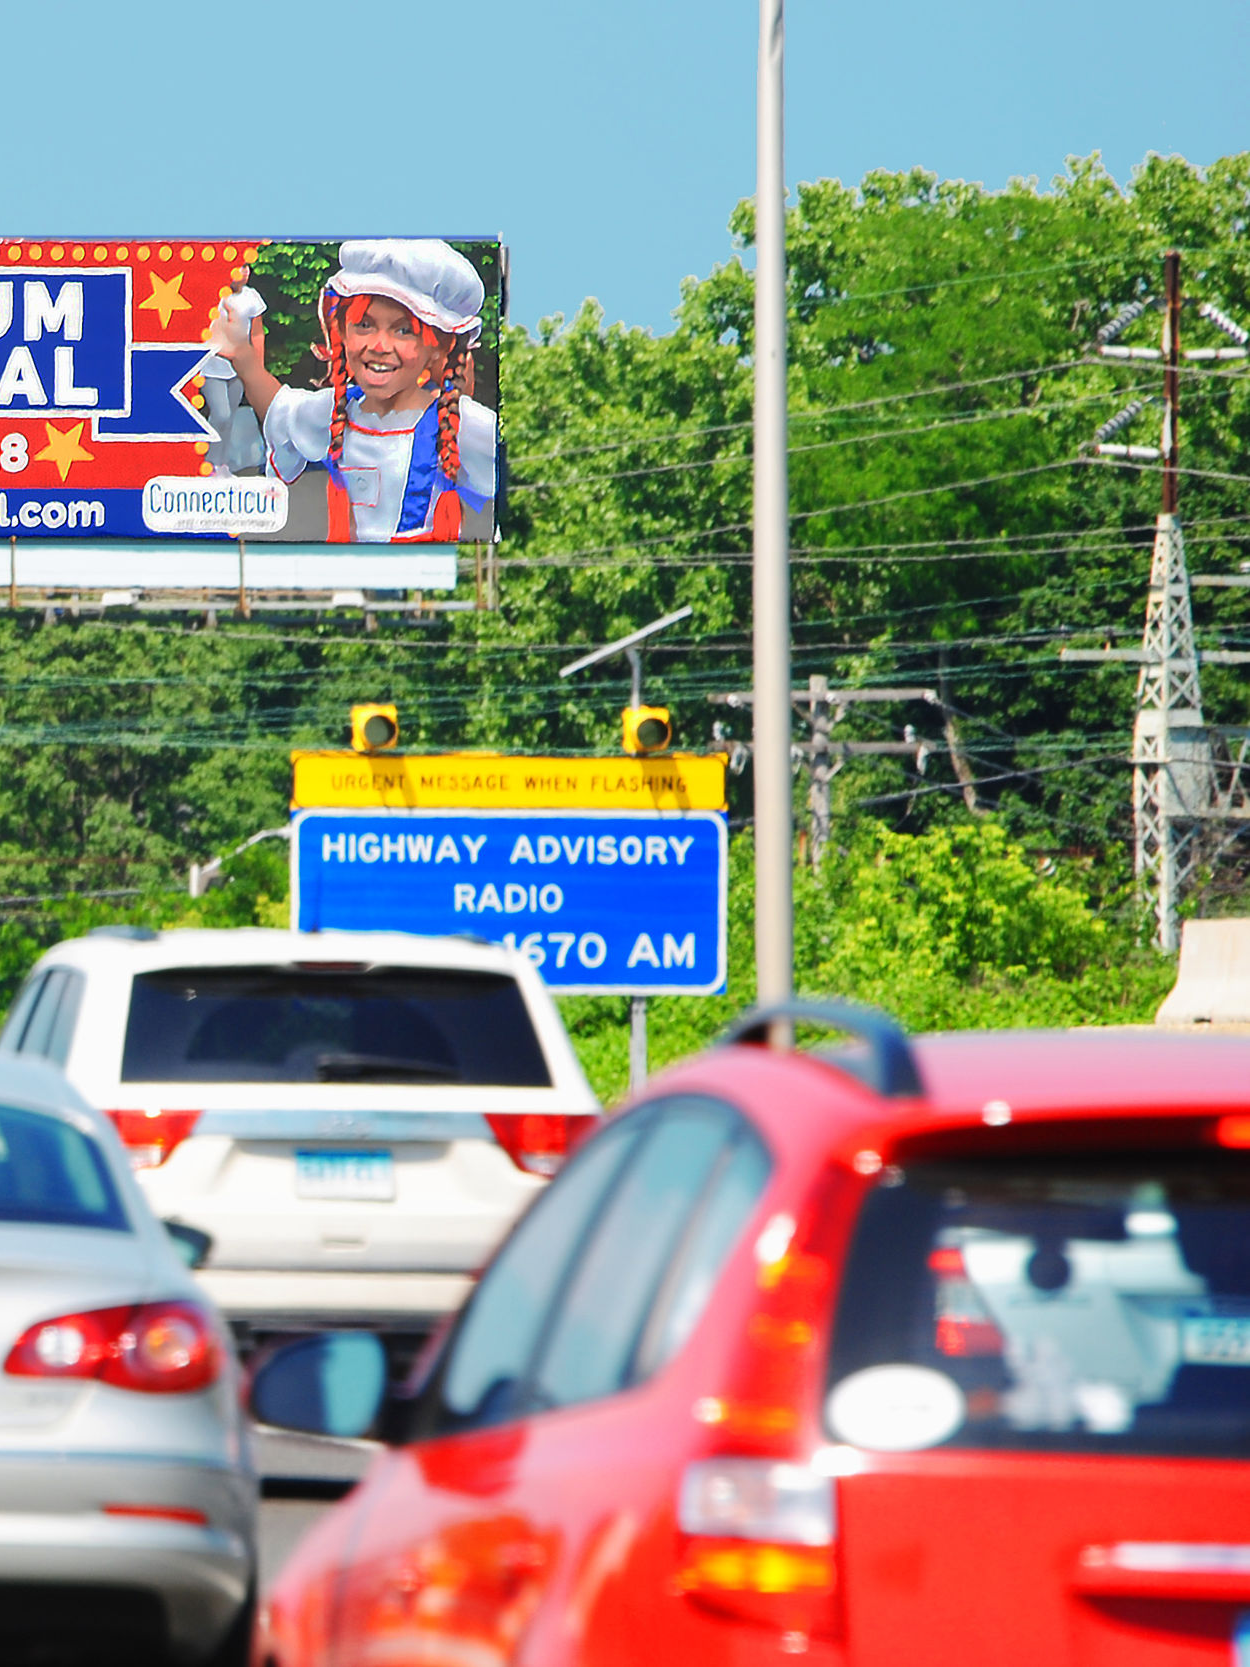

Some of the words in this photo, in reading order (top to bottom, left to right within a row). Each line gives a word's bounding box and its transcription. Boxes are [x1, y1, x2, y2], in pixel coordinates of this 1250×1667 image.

[149, 483, 276, 514] Connecticut
[331, 773, 406, 792] URGENT
[420, 774, 510, 793] MESSAGE
[525, 775, 580, 793] WHEN
[590, 776, 688, 794] FLASHING
[322, 832, 488, 865] HIGHWAY
[509, 834, 694, 866] ADVISORY
[453, 882, 565, 915] RADIO
[626, 932, 696, 970] AM
